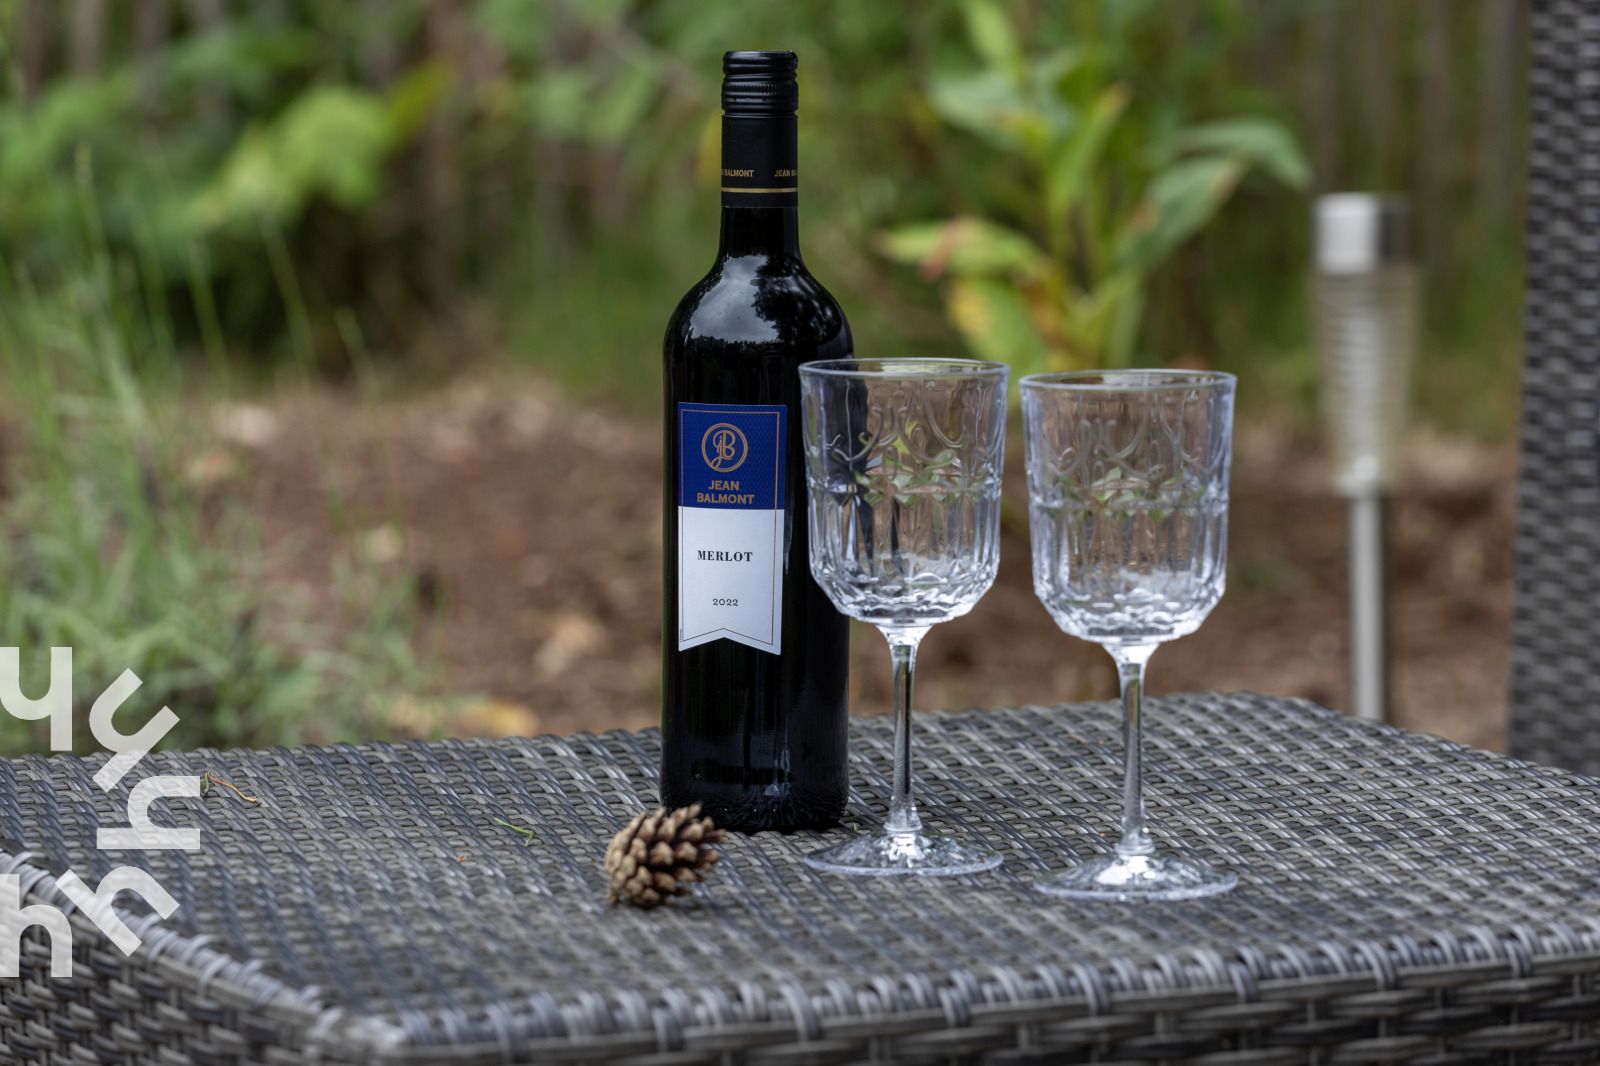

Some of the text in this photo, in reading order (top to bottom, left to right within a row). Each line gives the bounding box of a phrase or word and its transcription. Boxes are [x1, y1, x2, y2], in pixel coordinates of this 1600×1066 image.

[708, 479, 740, 491] JEAN
[696, 492, 755, 505] BALMONT
[697, 550, 753, 563] MERLOT
[712, 598, 739, 607] 2022
